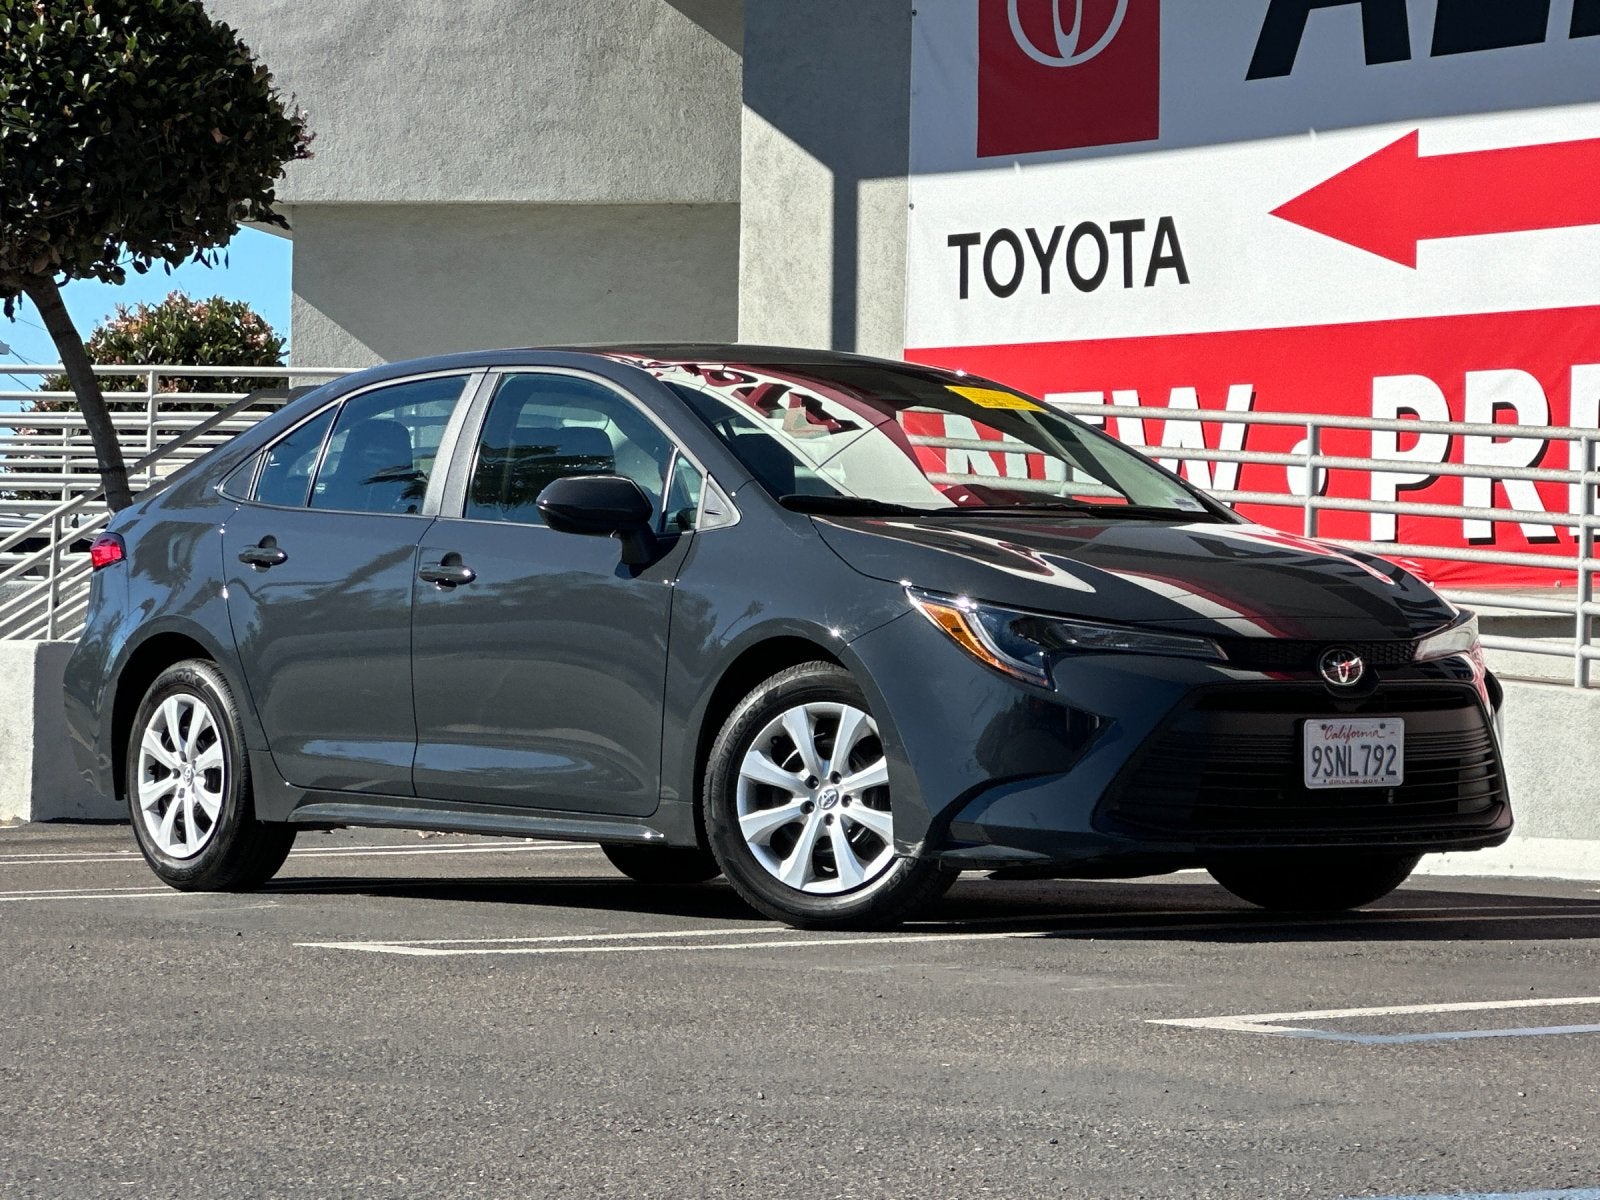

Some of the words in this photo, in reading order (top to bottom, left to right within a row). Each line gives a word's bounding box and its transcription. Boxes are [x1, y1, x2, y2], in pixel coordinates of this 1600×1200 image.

[948, 216, 1190, 299] TOYOTA
[1324, 724, 1385, 744] California
[1312, 744, 1397, 778] 9SNL792
